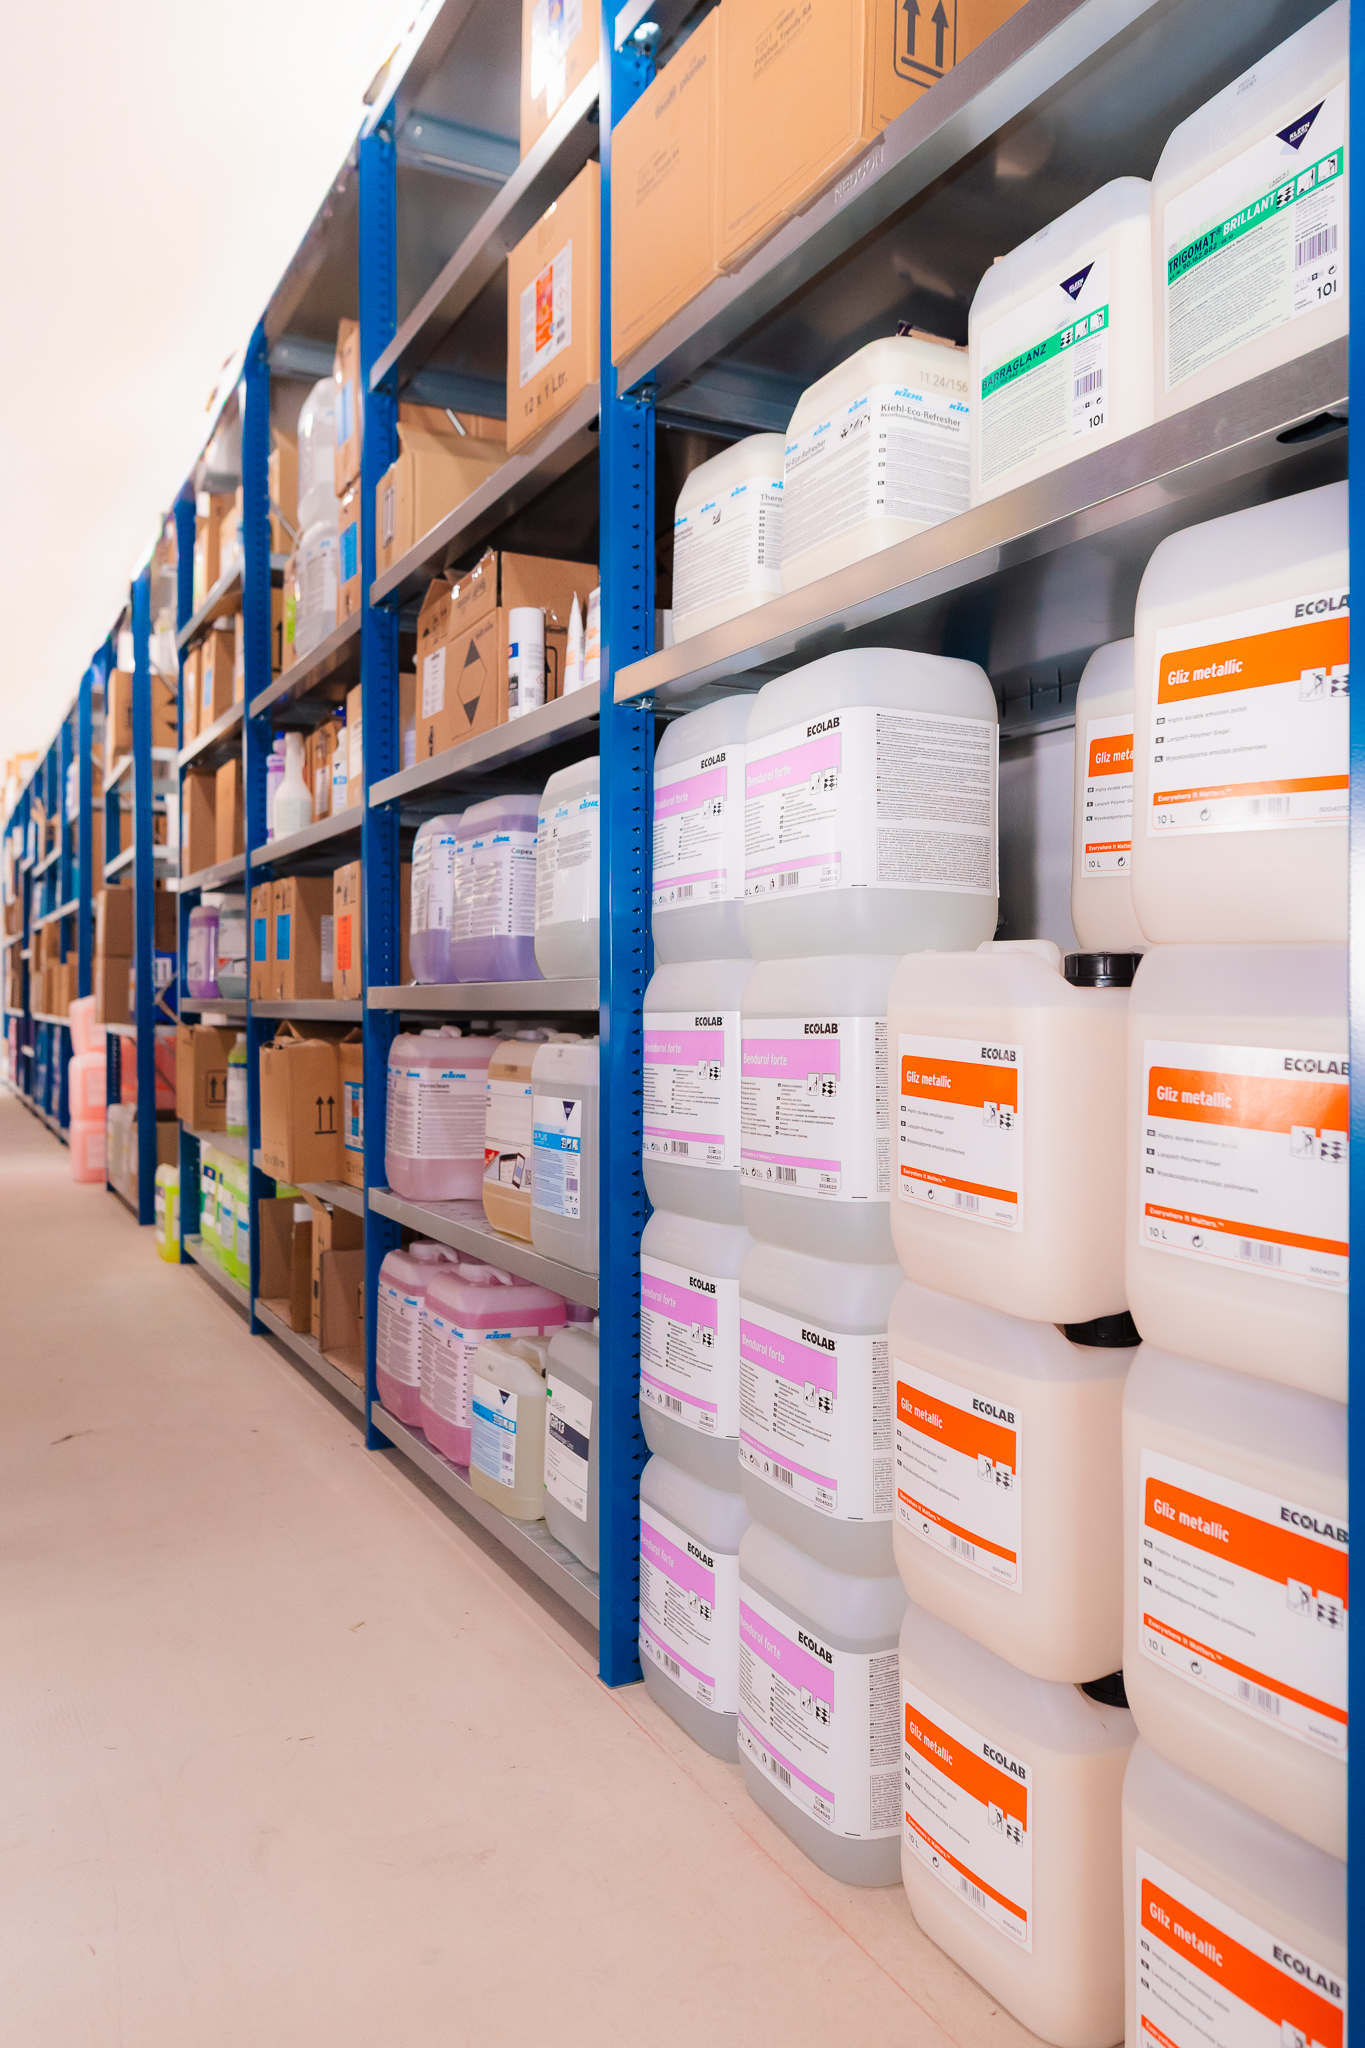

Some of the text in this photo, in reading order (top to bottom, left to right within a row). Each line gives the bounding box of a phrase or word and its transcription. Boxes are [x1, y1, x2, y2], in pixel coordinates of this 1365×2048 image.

[834, 148, 884, 202] NEDCON
[1222, 192, 1276, 236] BRILLANT
[982, 344, 1047, 391] BARRAGLANZ
[920, 371, 968, 393] 11.24/156
[525, 398, 533, 416] 12
[552, 372, 568, 394] Ltr.
[881, 404, 961, 427] Kiehl-Eco-Refresher
[1295, 595, 1350, 619] ECOLA
[1168, 658, 1243, 686] Gliz metallic
[1206, 709, 1229, 717] emulsion
[807, 717, 840, 738] ECOLAB
[701, 753, 726, 769] ECOLAB
[1095, 749, 1133, 764] Gliz meta
[746, 764, 791, 788] Bendurol forte
[579, 799, 599, 810] KIEHL
[676, 792, 689, 804] forte
[1095, 799, 1132, 807] Langzeit-Polymer-Sie
[1158, 793, 1191, 802] Everywhere
[1158, 815, 1175, 824] 10 L
[511, 847, 533, 855] Copex
[695, 1017, 723, 1026] ECOLAB
[804, 1023, 838, 1034] ECOLAB
[668, 1043, 682, 1054] forte
[981, 1047, 1016, 1062] ECOLAB
[743, 1053, 787, 1066] Bendurol forte
[1284, 1057, 1349, 1075] ECOLAB
[906, 1071, 952, 1088] Gliz metallic
[1156, 1085, 1233, 1109] Gliz metallic
[903, 1184, 914, 1194] 10 L
[1149, 1206, 1184, 1221] Everywhere
[1149, 1227, 1167, 1240] 10 L
[689, 1276, 716, 1294] ECOLAB
[663, 1294, 676, 1308] forte
[742, 1334, 785, 1364] Bendurol forte
[802, 1328, 836, 1351] ECOLAB
[901, 1396, 943, 1429] Gliz metallic
[972, 1398, 1015, 1424] ECOLAB
[900, 1507, 911, 1521] 10 L
[1153, 1498, 1230, 1544] Gliz metallic
[1280, 1506, 1349, 1545] ECOLAB
[660, 1547, 675, 1568] forte
[687, 1542, 714, 1568] ECOLAB
[1148, 1618, 1182, 1643] Everywhere
[764, 1637, 781, 1660] forte
[798, 1630, 832, 1664] ECOLAB
[1149, 1638, 1167, 1656] 10 L
[909, 1721, 954, 1766] Gliz metallic
[983, 1742, 1027, 1780] ECOLAB
[908, 1832, 920, 1849] 10 L
[1149, 1901, 1224, 1968] Gliz metallic
[1272, 1944, 1342, 2000] ECOLAB
